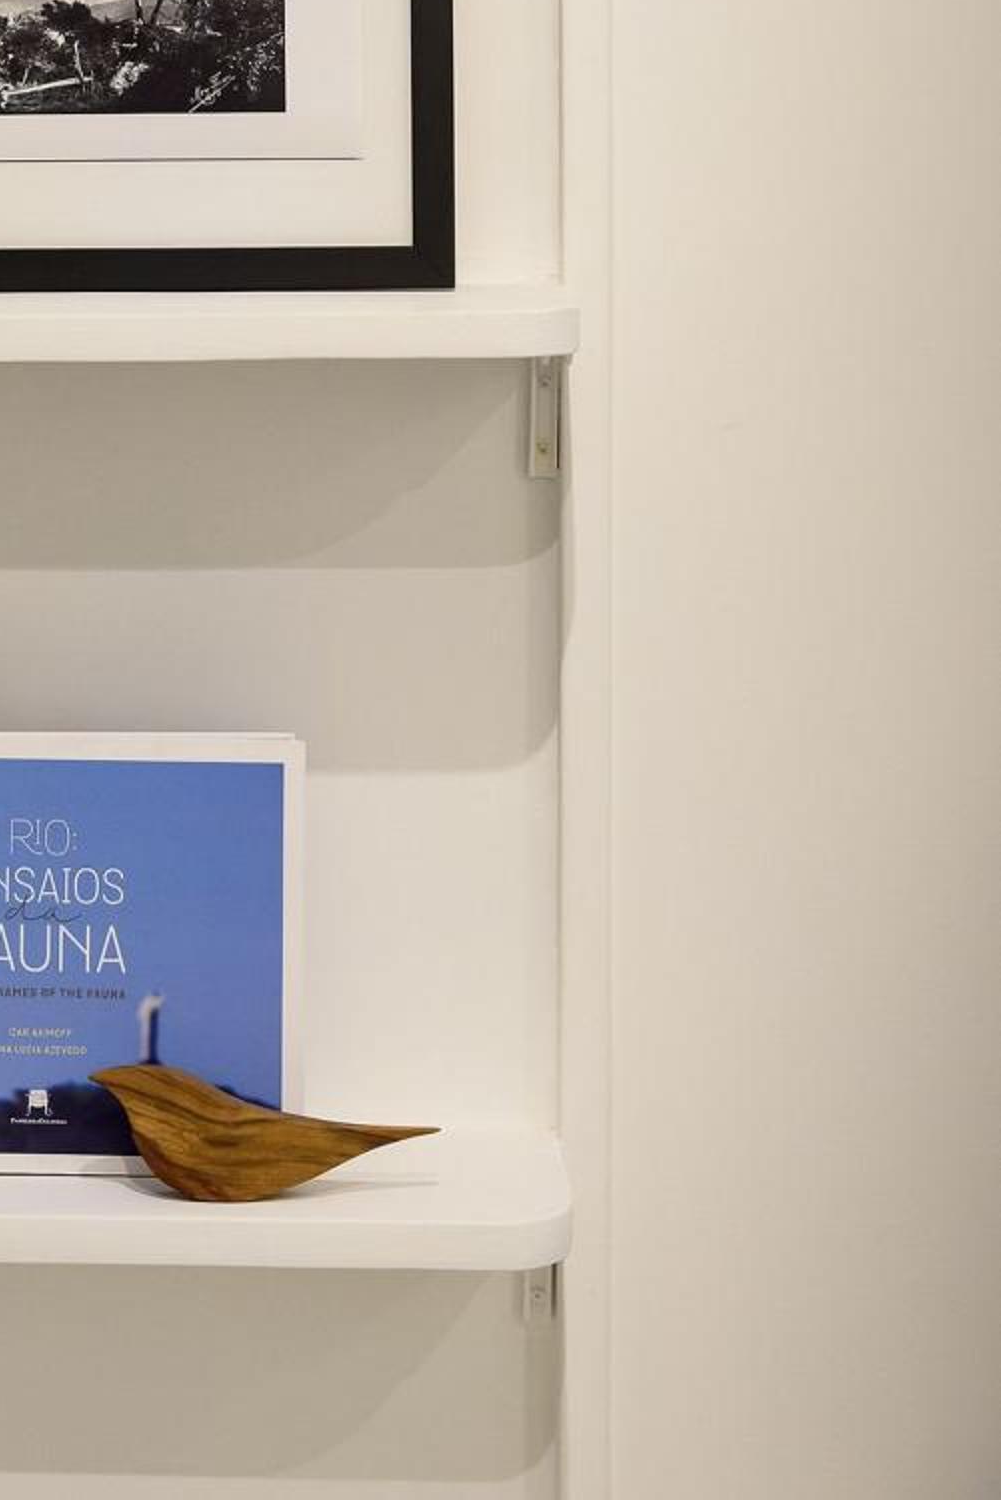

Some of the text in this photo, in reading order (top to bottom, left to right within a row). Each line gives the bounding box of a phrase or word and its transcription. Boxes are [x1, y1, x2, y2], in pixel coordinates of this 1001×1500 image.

[9, 818, 78, 856] RIO:
[40, 987, 56, 999] OF
[59, 987, 82, 1000] THE
[86, 987, 127, 1000] FAUNA
